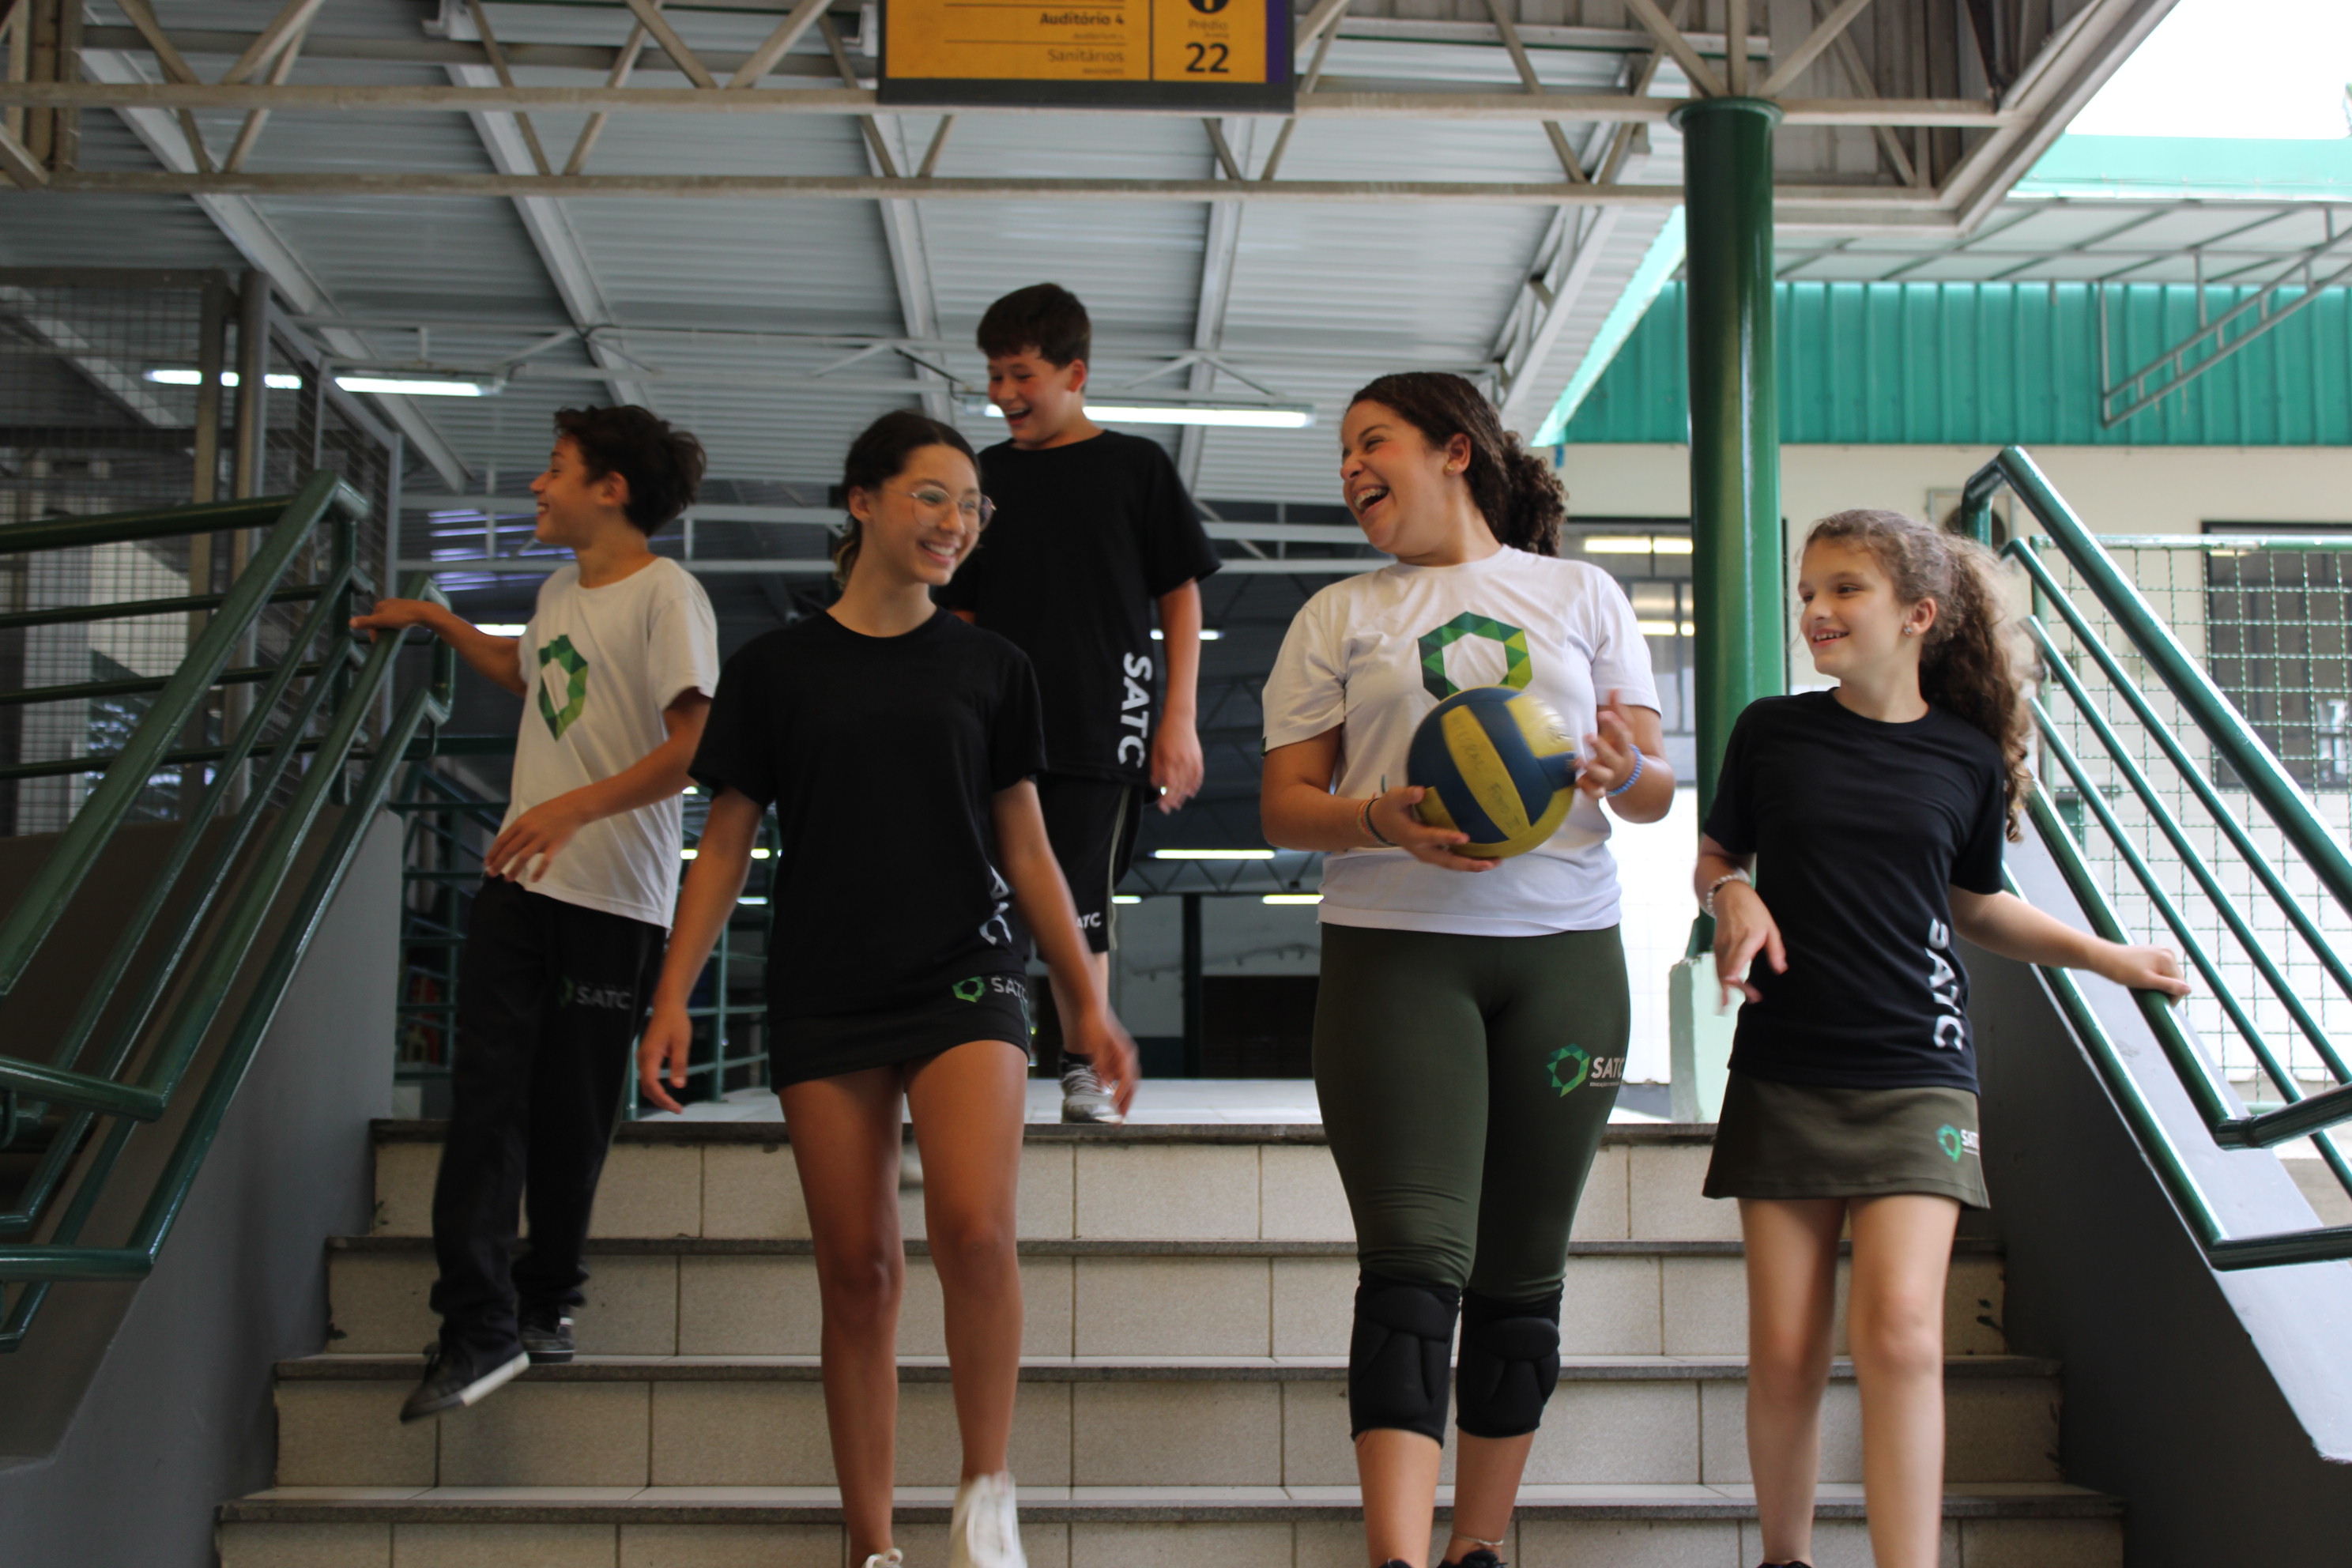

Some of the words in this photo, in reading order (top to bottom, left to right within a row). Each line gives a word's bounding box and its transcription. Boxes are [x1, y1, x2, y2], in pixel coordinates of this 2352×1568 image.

[1039, 10, 1112, 25] Auditório
[1115, 13, 1125, 25] 4
[1047, 48, 1125, 62] Sanitários
[1185, 43, 1230, 73] 22
[1118, 652, 1153, 768] SATC
[1076, 911, 1102, 929] ATC
[1924, 918, 1965, 1051] SATC
[575, 986, 631, 1010] SATC
